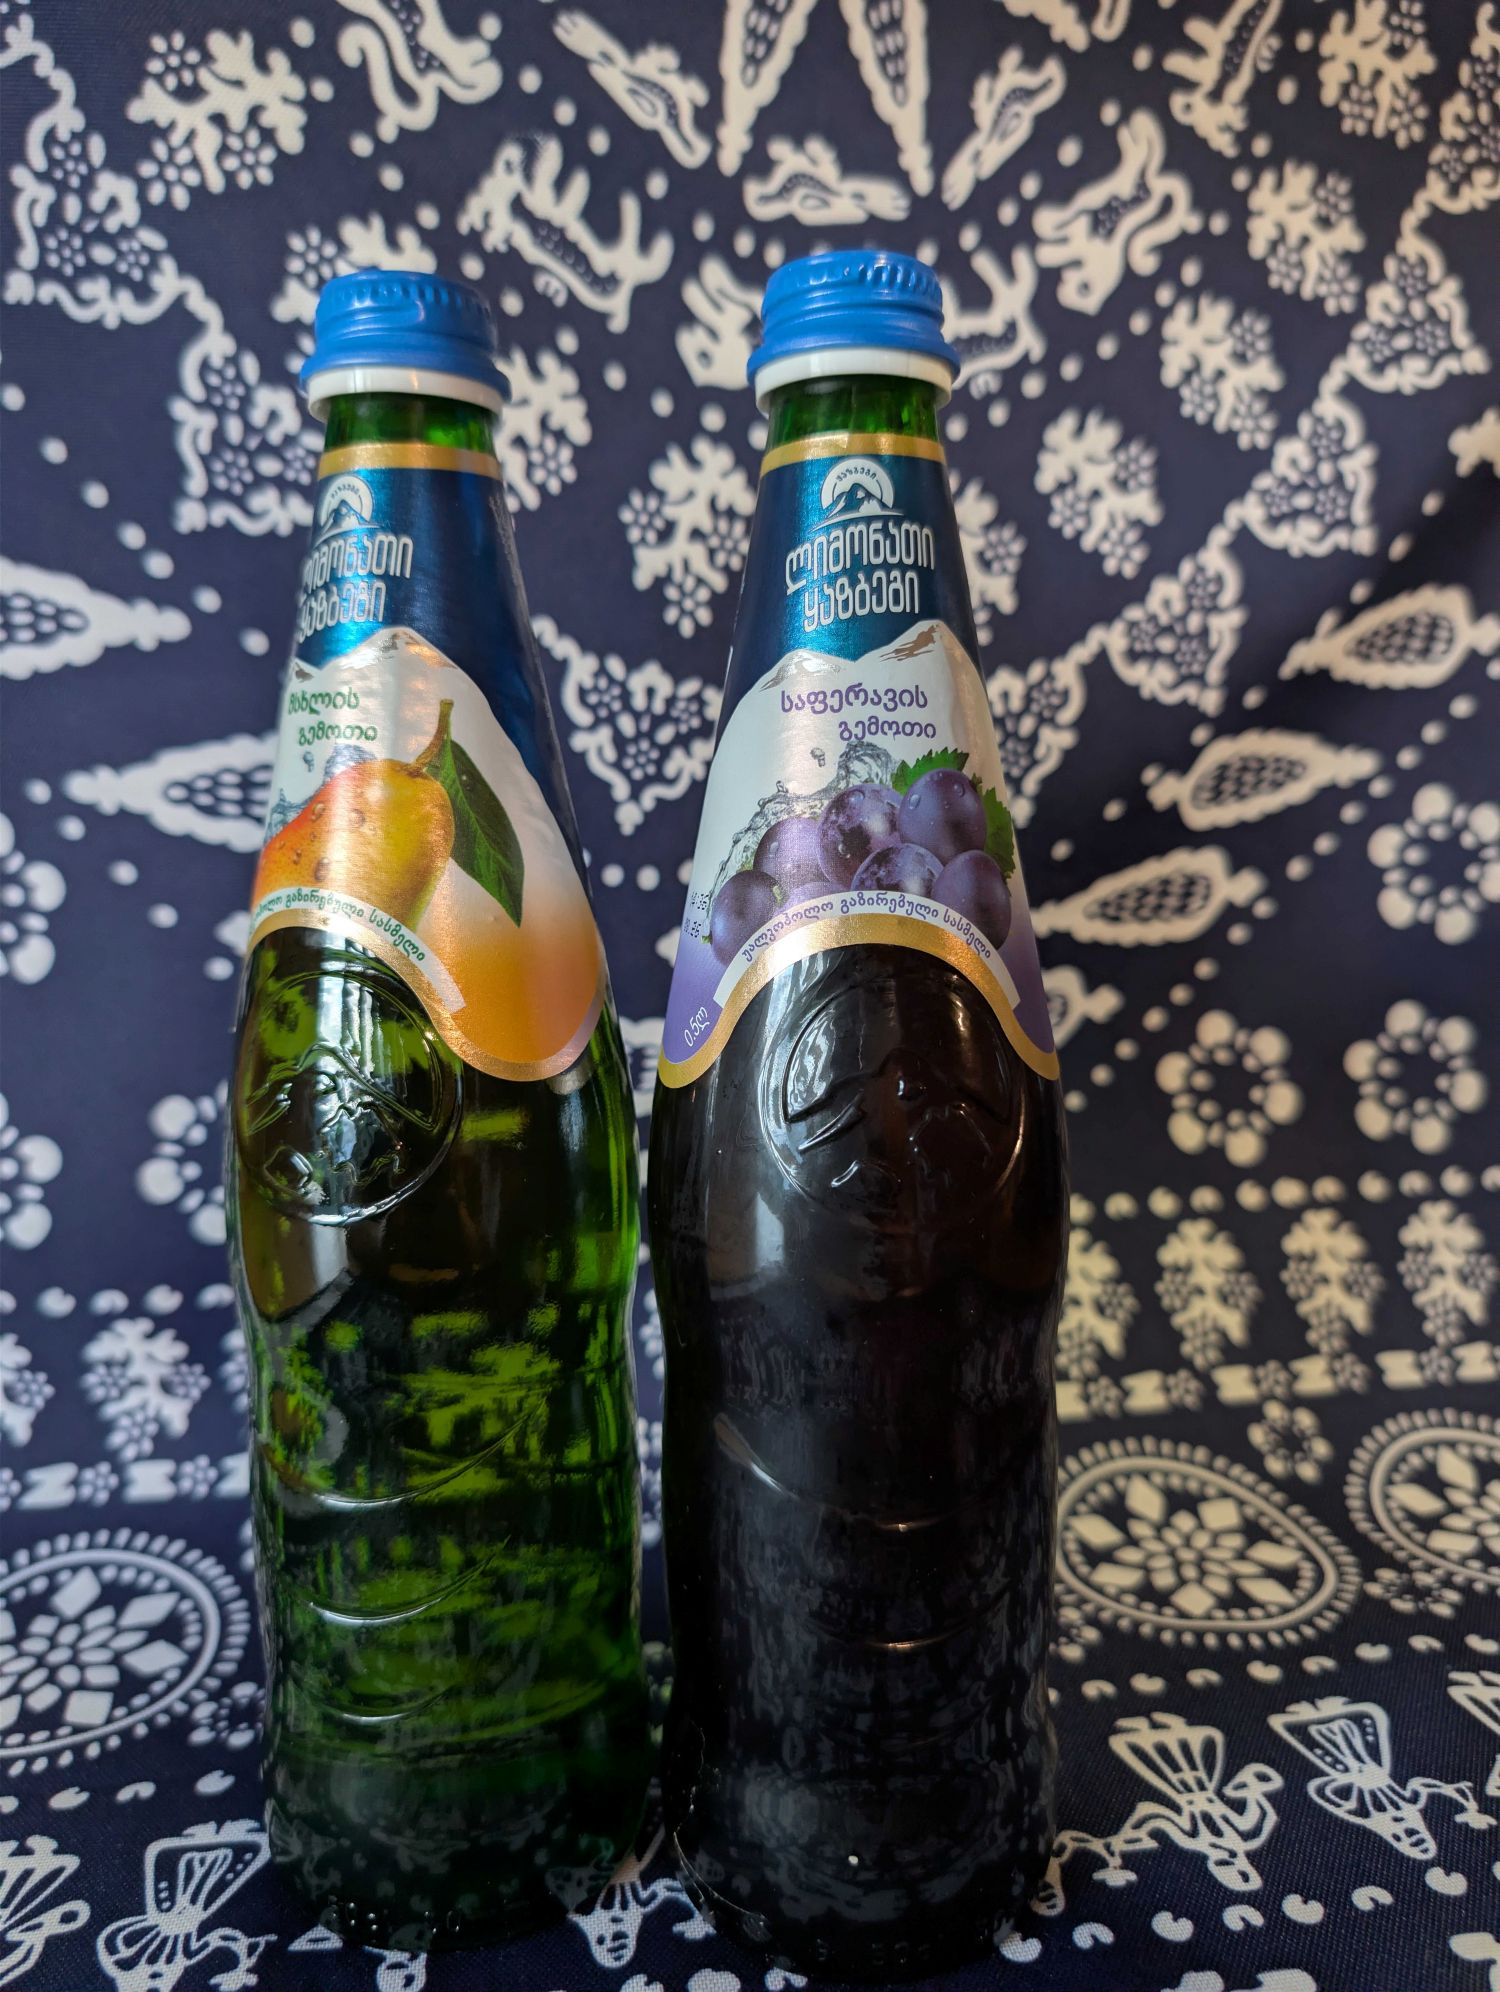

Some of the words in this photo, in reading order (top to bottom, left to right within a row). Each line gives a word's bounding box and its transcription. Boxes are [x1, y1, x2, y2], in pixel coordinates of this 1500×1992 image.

[785, 520, 935, 596] ლიმონათი
[803, 568, 919, 633] ყაზბეგი
[288, 686, 360, 715] მსხლის
[781, 682, 928, 715] საფერავის
[298, 720, 378, 747] გემოთი
[838, 715, 937, 742] გემოთი
[285, 887, 364, 919] გაზირებული
[368, 908, 426, 962] სასმელი
[741, 901, 834, 962] უალკოჰოლო
[840, 891, 938, 920] გაზირებული
[943, 910, 992, 959] სასმელი
